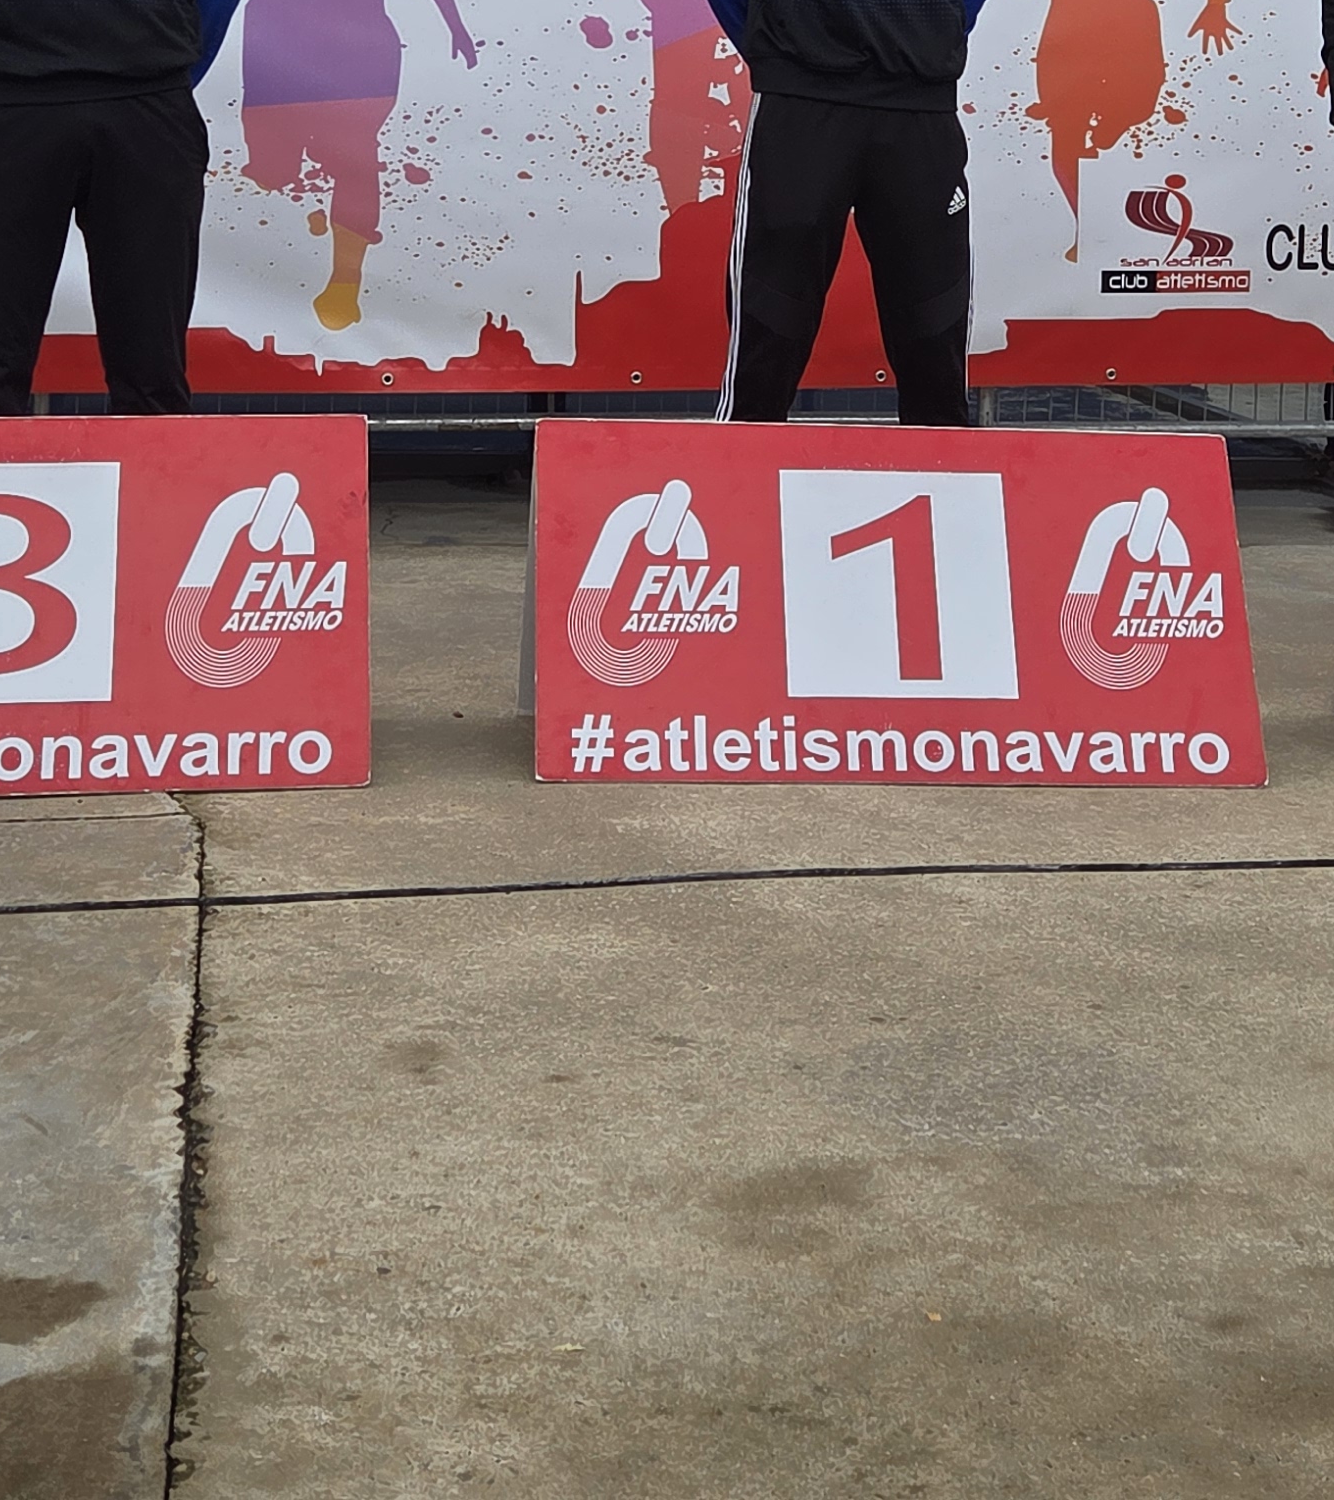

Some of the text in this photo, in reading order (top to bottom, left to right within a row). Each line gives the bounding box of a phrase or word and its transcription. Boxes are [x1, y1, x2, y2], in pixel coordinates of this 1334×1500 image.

[1108, 272, 1250, 290] club atletismo
[230, 560, 349, 611] FNA
[629, 565, 741, 612] FNA
[830, 493, 944, 681] 1
[1120, 571, 1225, 619] FNA
[220, 608, 344, 635] ATLETISMO
[620, 611, 739, 635] ATLETISMO
[1112, 616, 1225, 640] ATLETISMO
[570, 714, 1231, 775] #atletismonavarro
